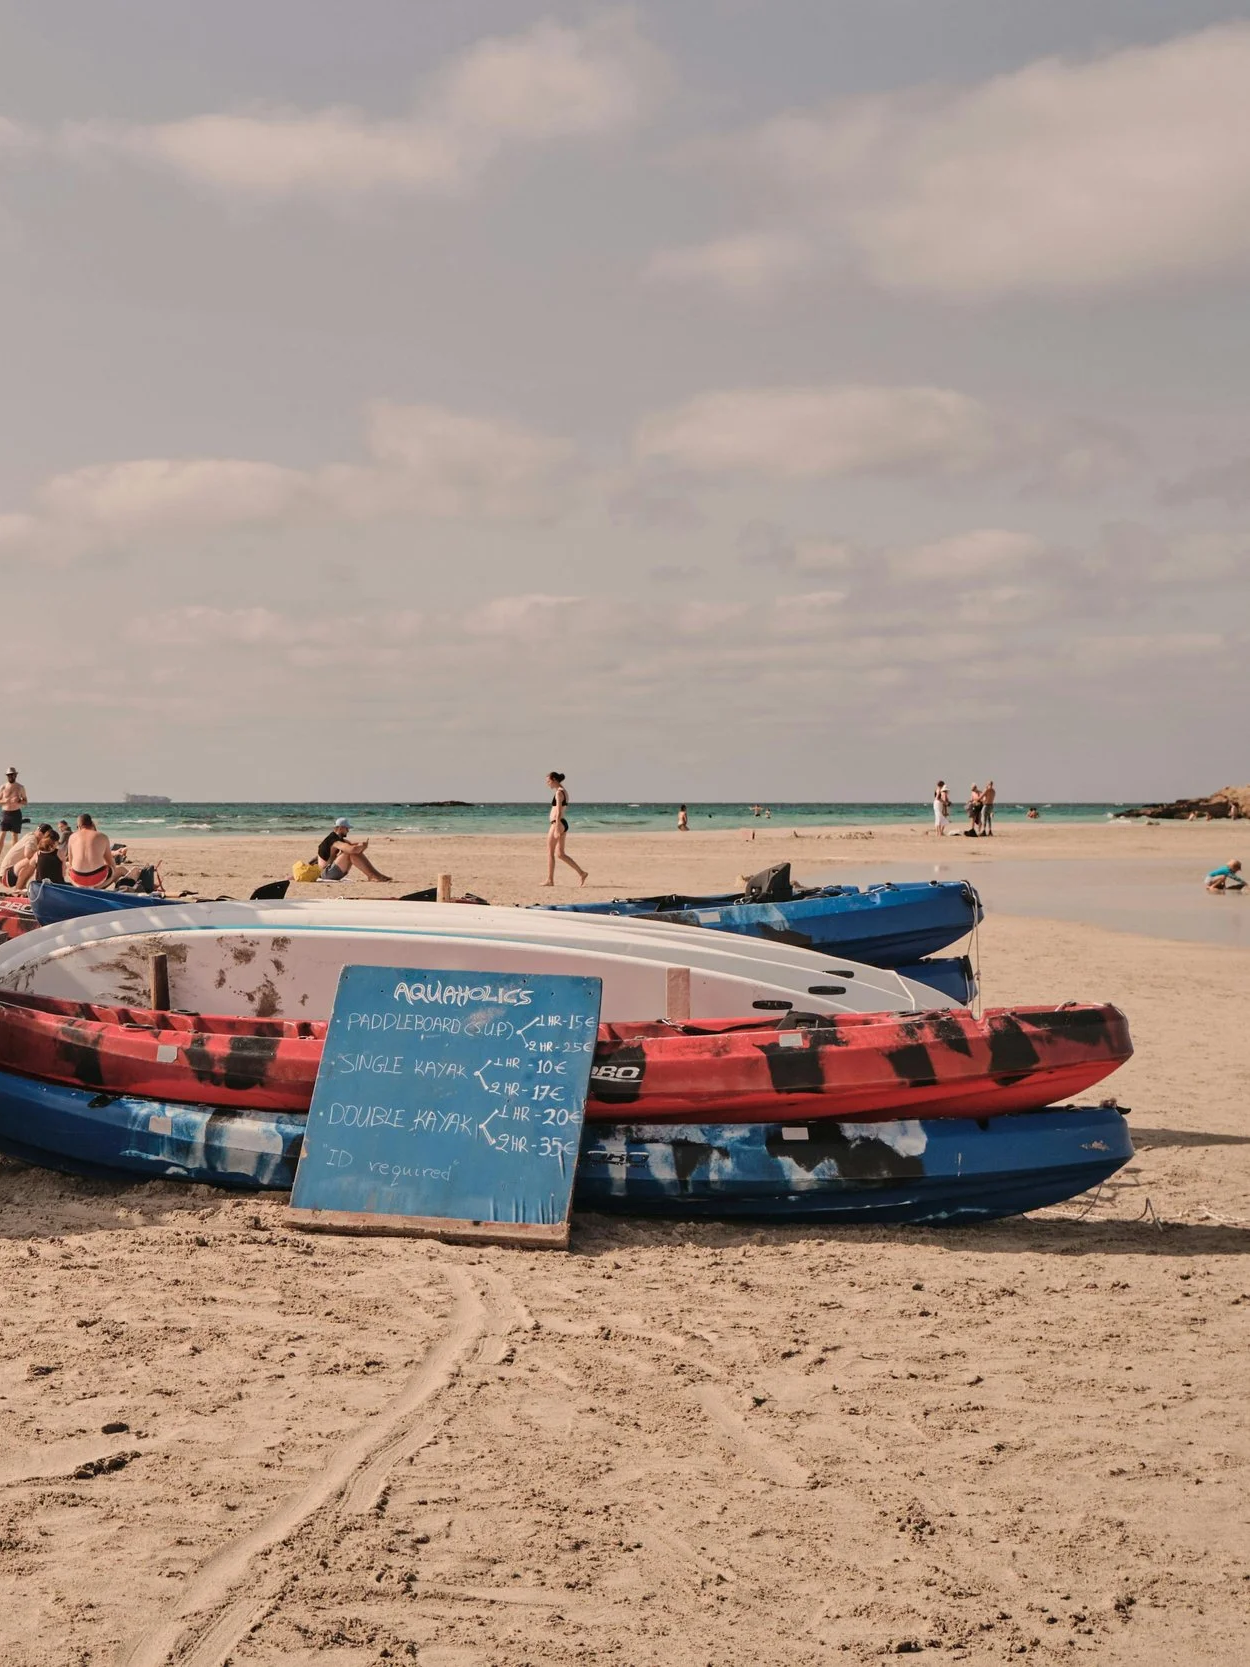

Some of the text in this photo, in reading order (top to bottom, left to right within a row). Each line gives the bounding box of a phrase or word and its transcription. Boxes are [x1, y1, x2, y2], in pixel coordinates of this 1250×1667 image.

[393, 980, 534, 1007] AQUAHOLICS
[348, 1012, 461, 1034] PADDLEBOARD
[562, 1042, 594, 1053] 25€
[339, 1053, 468, 1080] SINGLE KAYAK
[505, 1057, 521, 1070] HR
[504, 1082, 520, 1097] HR
[327, 1102, 473, 1136] DOUBLE KAYAK
[512, 1106, 530, 1121] HR
[542, 1108, 585, 1126] 20€
[538, 1136, 579, 1157] 35€
